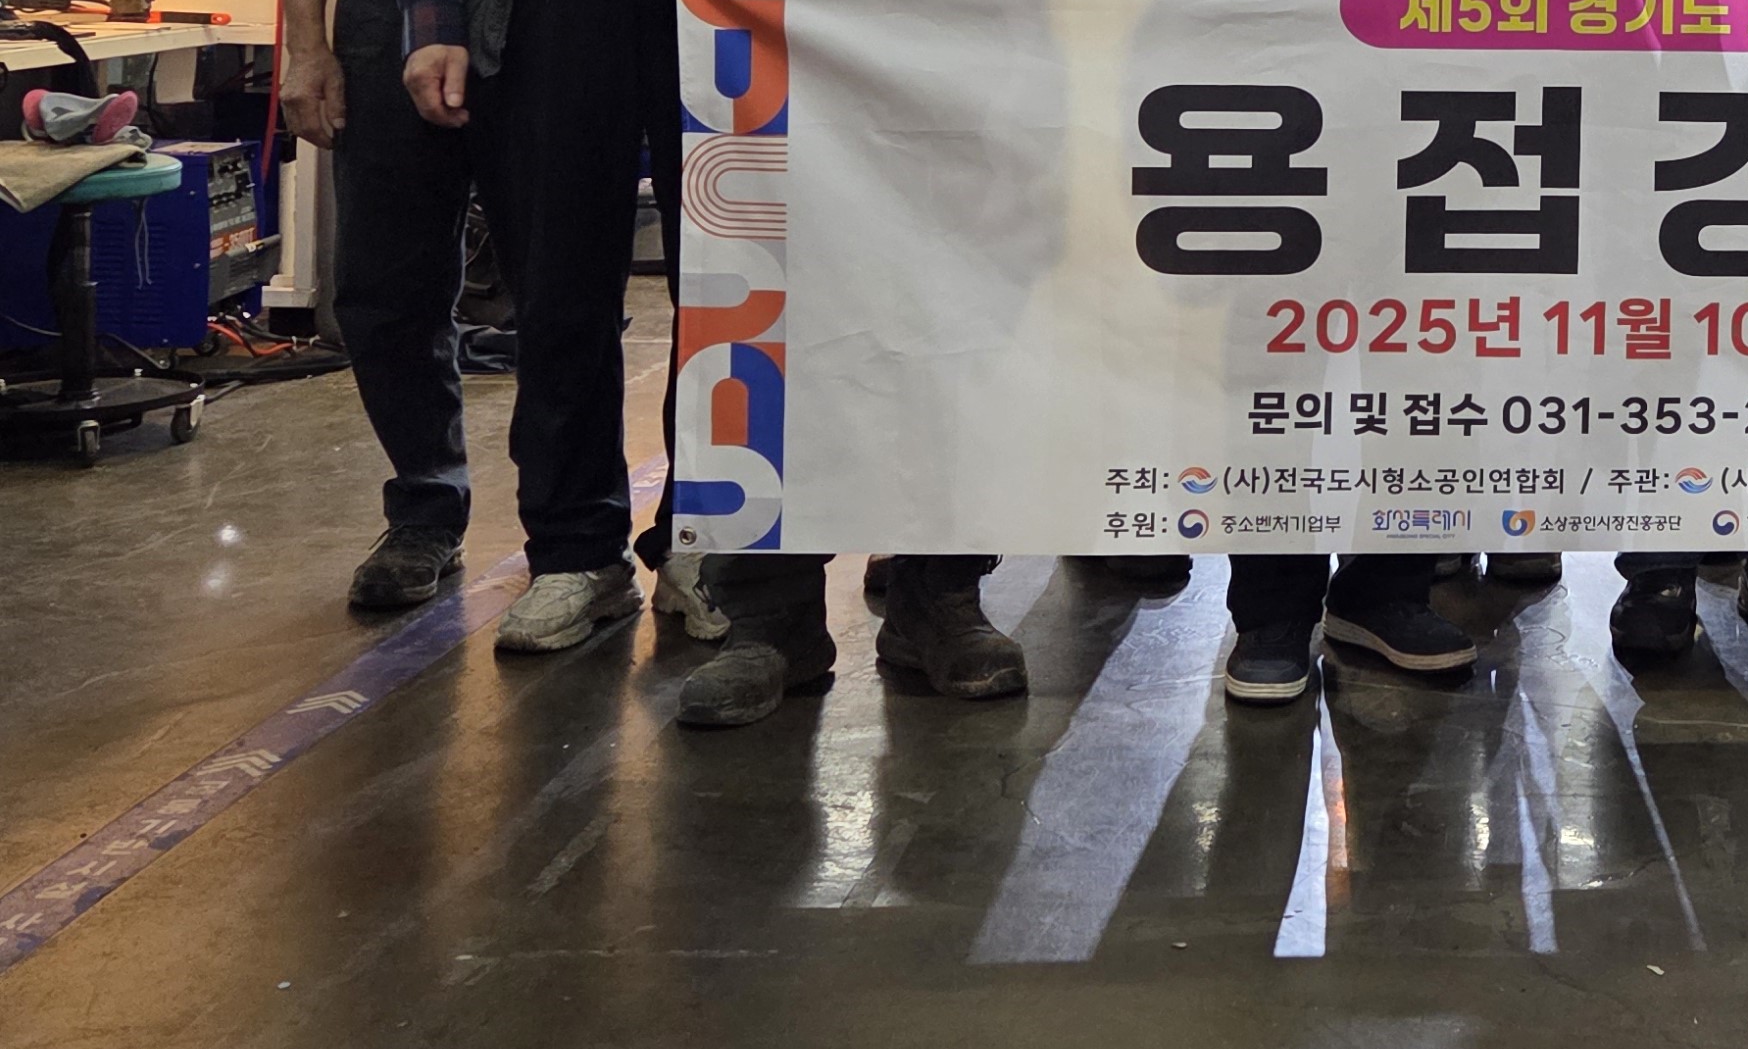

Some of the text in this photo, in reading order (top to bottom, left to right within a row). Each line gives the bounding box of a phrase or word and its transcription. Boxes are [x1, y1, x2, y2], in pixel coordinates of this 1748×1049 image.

[1266, 296, 1522, 359] 2025년
[1544, 298, 1672, 360] 11월
[1248, 392, 1333, 435] 문의
[1350, 392, 1389, 436] 및
[1403, 392, 1488, 436] 접수
[1105, 467, 1169, 494] 주최:
[1223, 466, 1565, 495] (사)전국도시형소공인연합회
[1608, 467, 1670, 494] 주관:
[1104, 511, 1168, 538] 후원:
[1221, 515, 1342, 534] 중소벤처기업부
[1372, 509, 1471, 532] 화성특례시
[1539, 514, 1682, 532] 소상공인시장진흥공단
